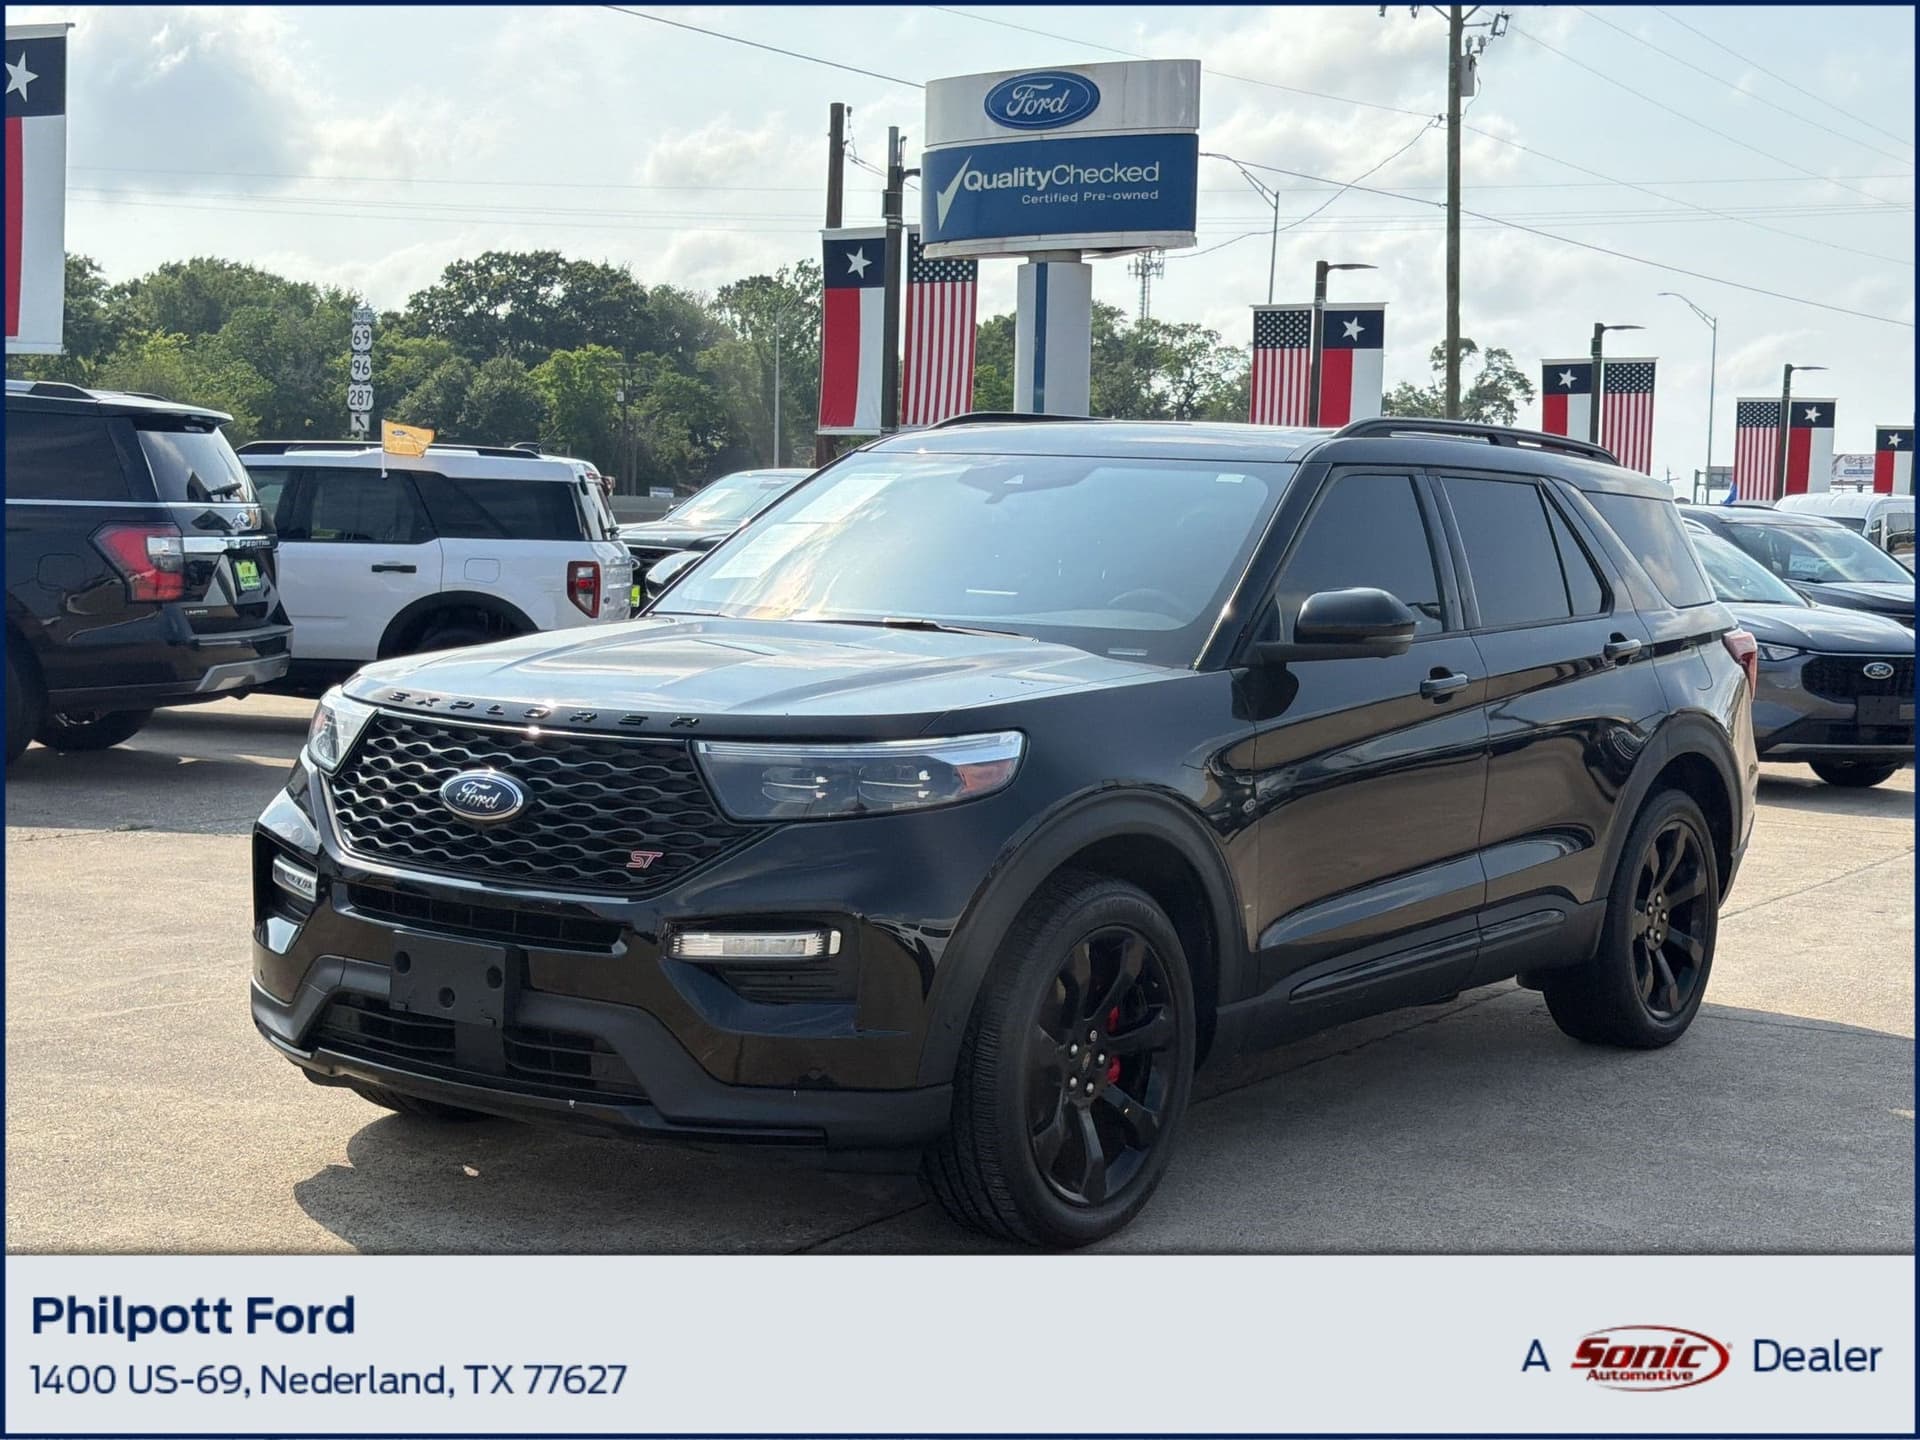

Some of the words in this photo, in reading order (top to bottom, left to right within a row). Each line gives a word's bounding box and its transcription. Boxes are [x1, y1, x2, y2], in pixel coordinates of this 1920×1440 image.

[1006, 83, 1070, 117] Ford
[1022, 192, 1078, 204] Certified
[1083, 190, 1159, 202] Pre-owned
[353, 330, 370, 345] 69
[353, 360, 370, 375] 96
[350, 390, 371, 406] 287
[389, 691, 700, 728] EXPLORER
[455, 781, 501, 809] Ford
[626, 850, 664, 869] ST
